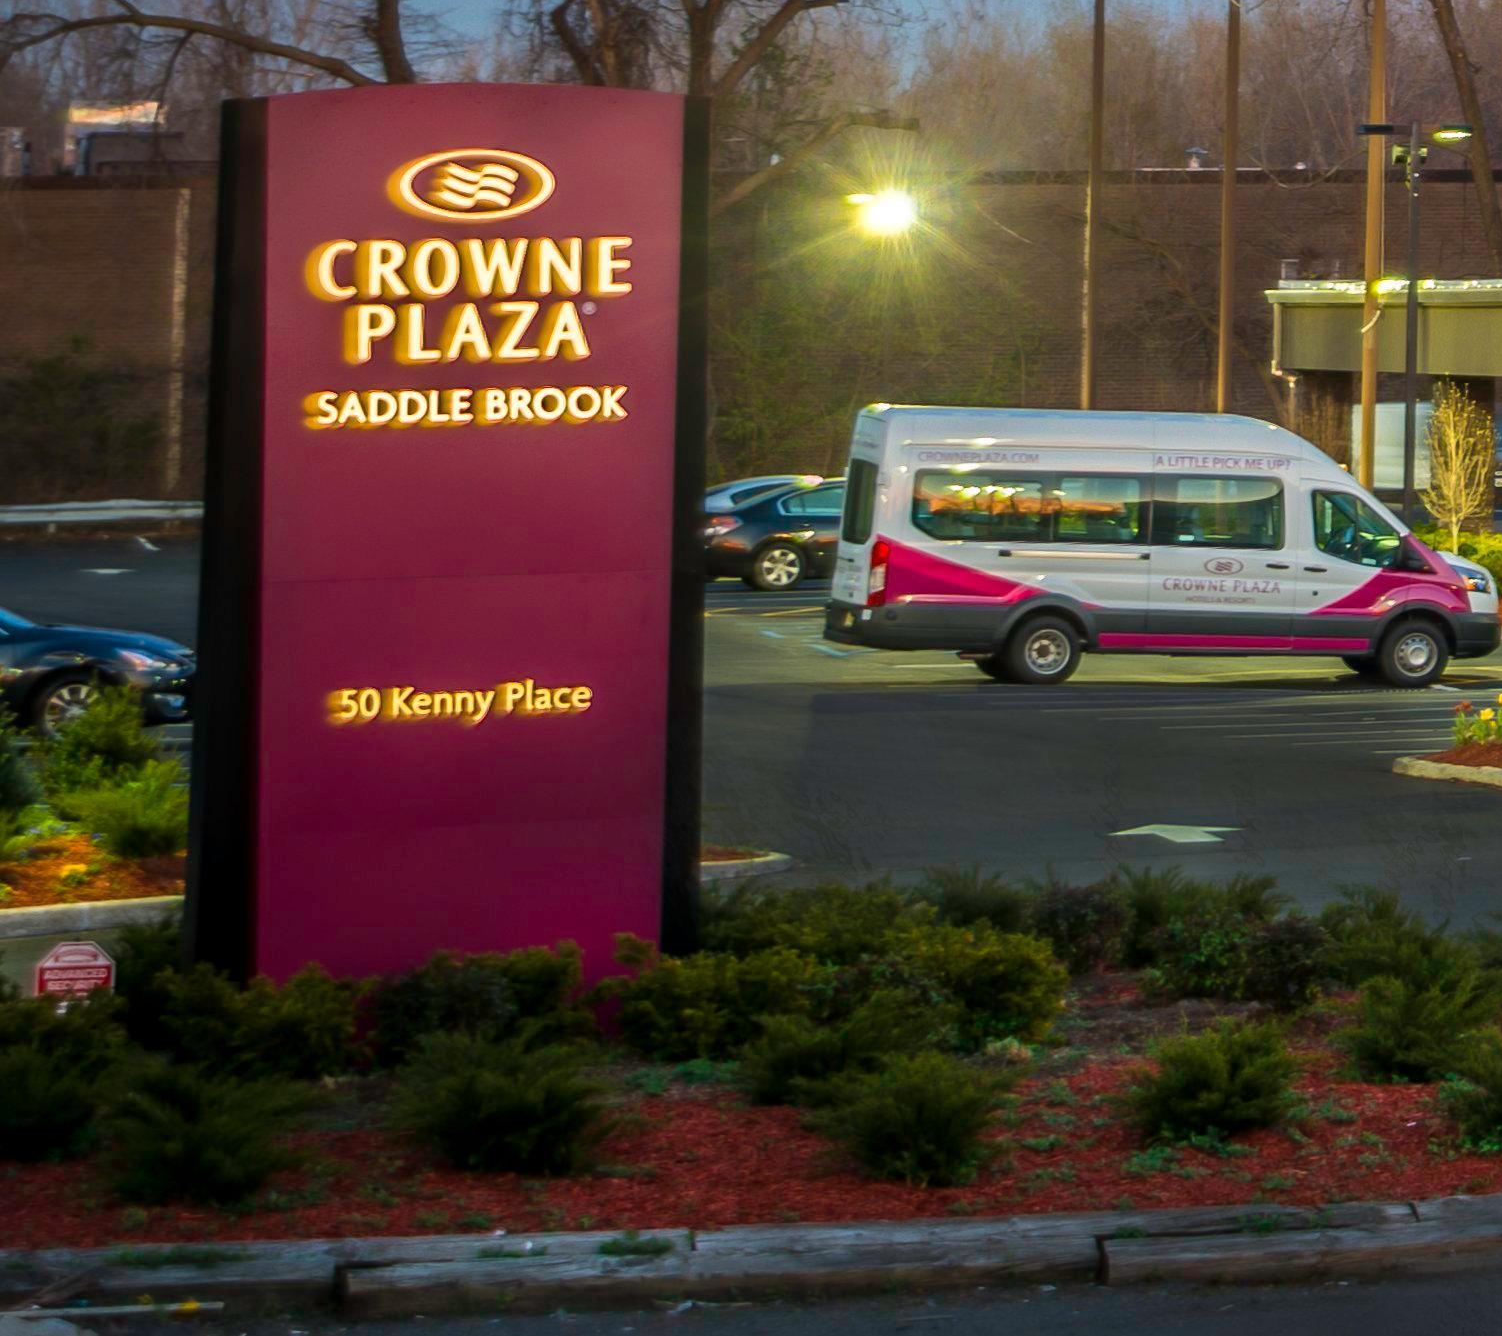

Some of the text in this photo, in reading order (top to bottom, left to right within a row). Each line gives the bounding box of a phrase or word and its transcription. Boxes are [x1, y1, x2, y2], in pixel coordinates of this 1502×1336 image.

[307, 236, 633, 300] CROWNE
[346, 301, 591, 363] PLAZA
[306, 385, 629, 426] SADDLE BROOK
[917, 451, 1040, 464] CROWNEPLAZA.COM
[1155, 456, 1291, 470] A LITTLE PICK ME UP?
[1162, 577, 1281, 594] CROWNE PLAZA
[333, 678, 593, 725] 50 Kenny Place
